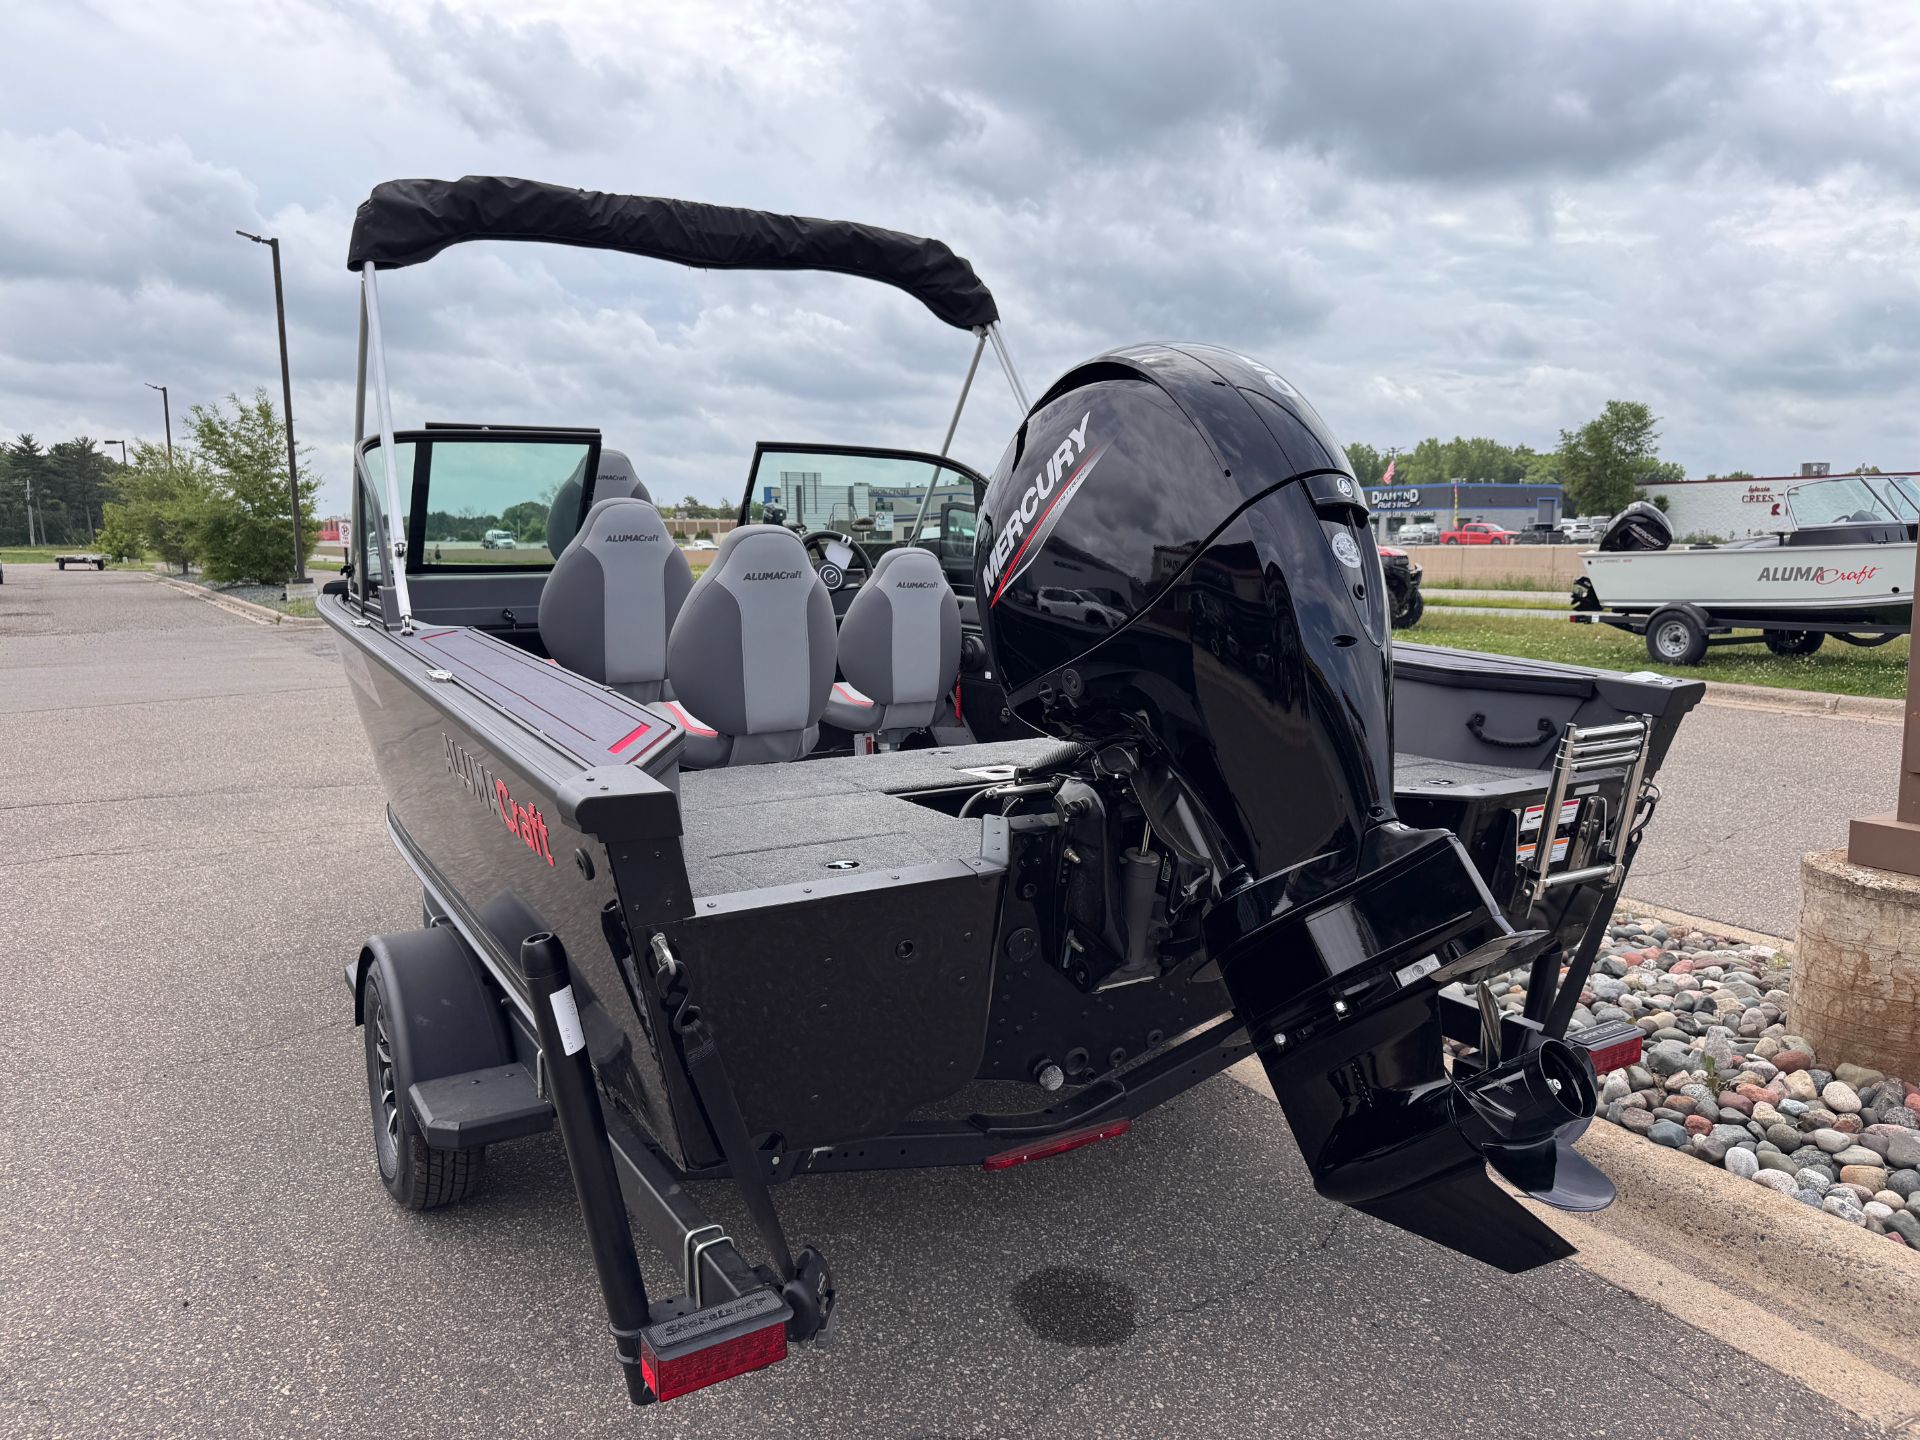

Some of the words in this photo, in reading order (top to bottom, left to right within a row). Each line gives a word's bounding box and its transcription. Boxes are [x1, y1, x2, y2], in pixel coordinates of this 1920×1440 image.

[982, 410, 1091, 598] MERCURY
[1742, 495, 1775, 503] CREES
[605, 534, 659, 543] ALUMACraft
[1629, 523, 1664, 546] MERCURY
[743, 570, 802, 581] ALUMACraft
[896, 581, 938, 589] ALUMACraft
